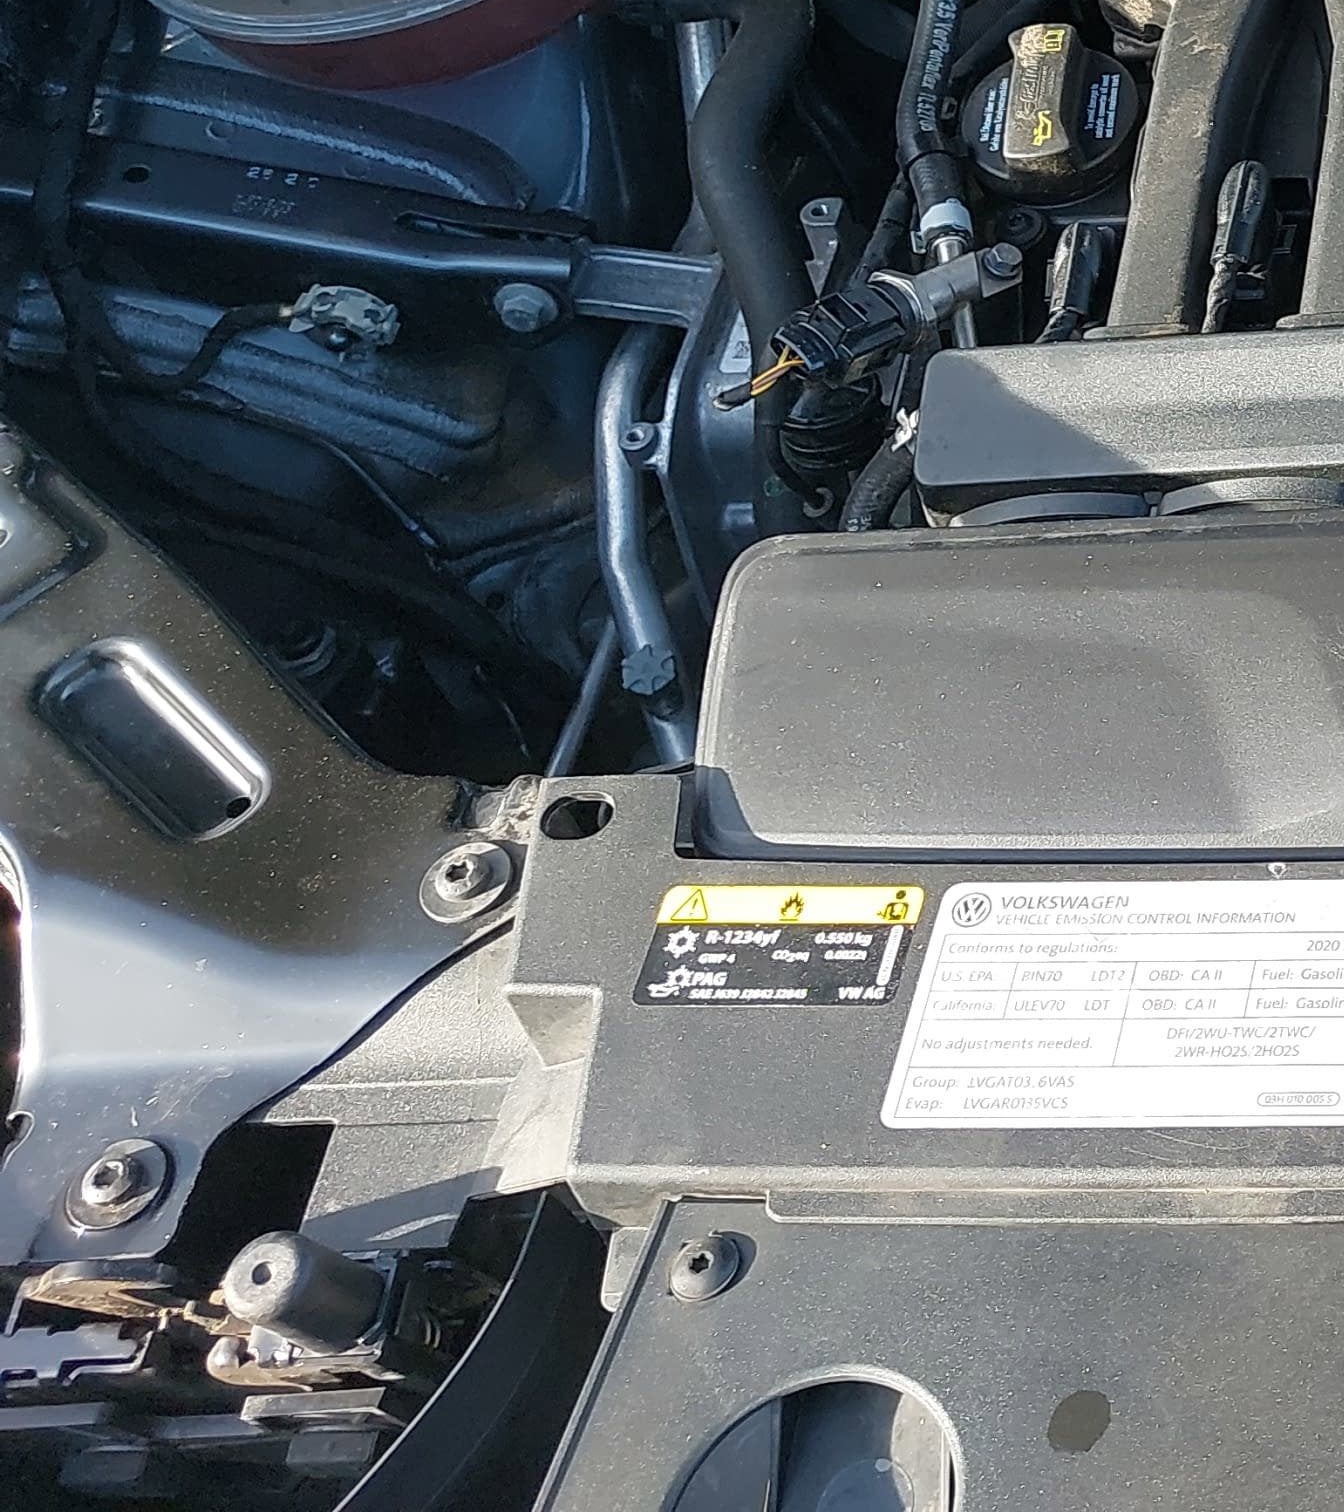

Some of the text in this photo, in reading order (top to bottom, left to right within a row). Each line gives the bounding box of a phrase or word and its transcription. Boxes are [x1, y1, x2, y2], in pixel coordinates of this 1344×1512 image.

[1001, 895, 1129, 910] VOLKSWAGEN
[996, 911, 1296, 925] VEHICLE EMISSION CONTROL INFORMATION
[705, 929, 781, 947] R-1234yf
[949, 941, 1118, 957] Conforms to regulations:
[1306, 940, 1340, 952] 2020
[691, 971, 728, 986] PAG
[968, 970, 993, 982] EPA
[1021, 969, 1063, 982] BIN70
[1149, 970, 1183, 982] OBD:
[1191, 969, 1209, 981] CA
[1262, 969, 1294, 980] Fuel:
[838, 987, 863, 999] VW
[1014, 999, 1110, 1011] ULEV70 LDT
[1142, 998, 1177, 1010] OBD:
[1185, 998, 1204, 1010] CA
[1256, 998, 1288, 1009] Fuel:
[921, 1036, 1093, 1053] No adjustments needed.
[912, 1076, 959, 1091] Group:
[905, 1097, 943, 1112] Evap:
